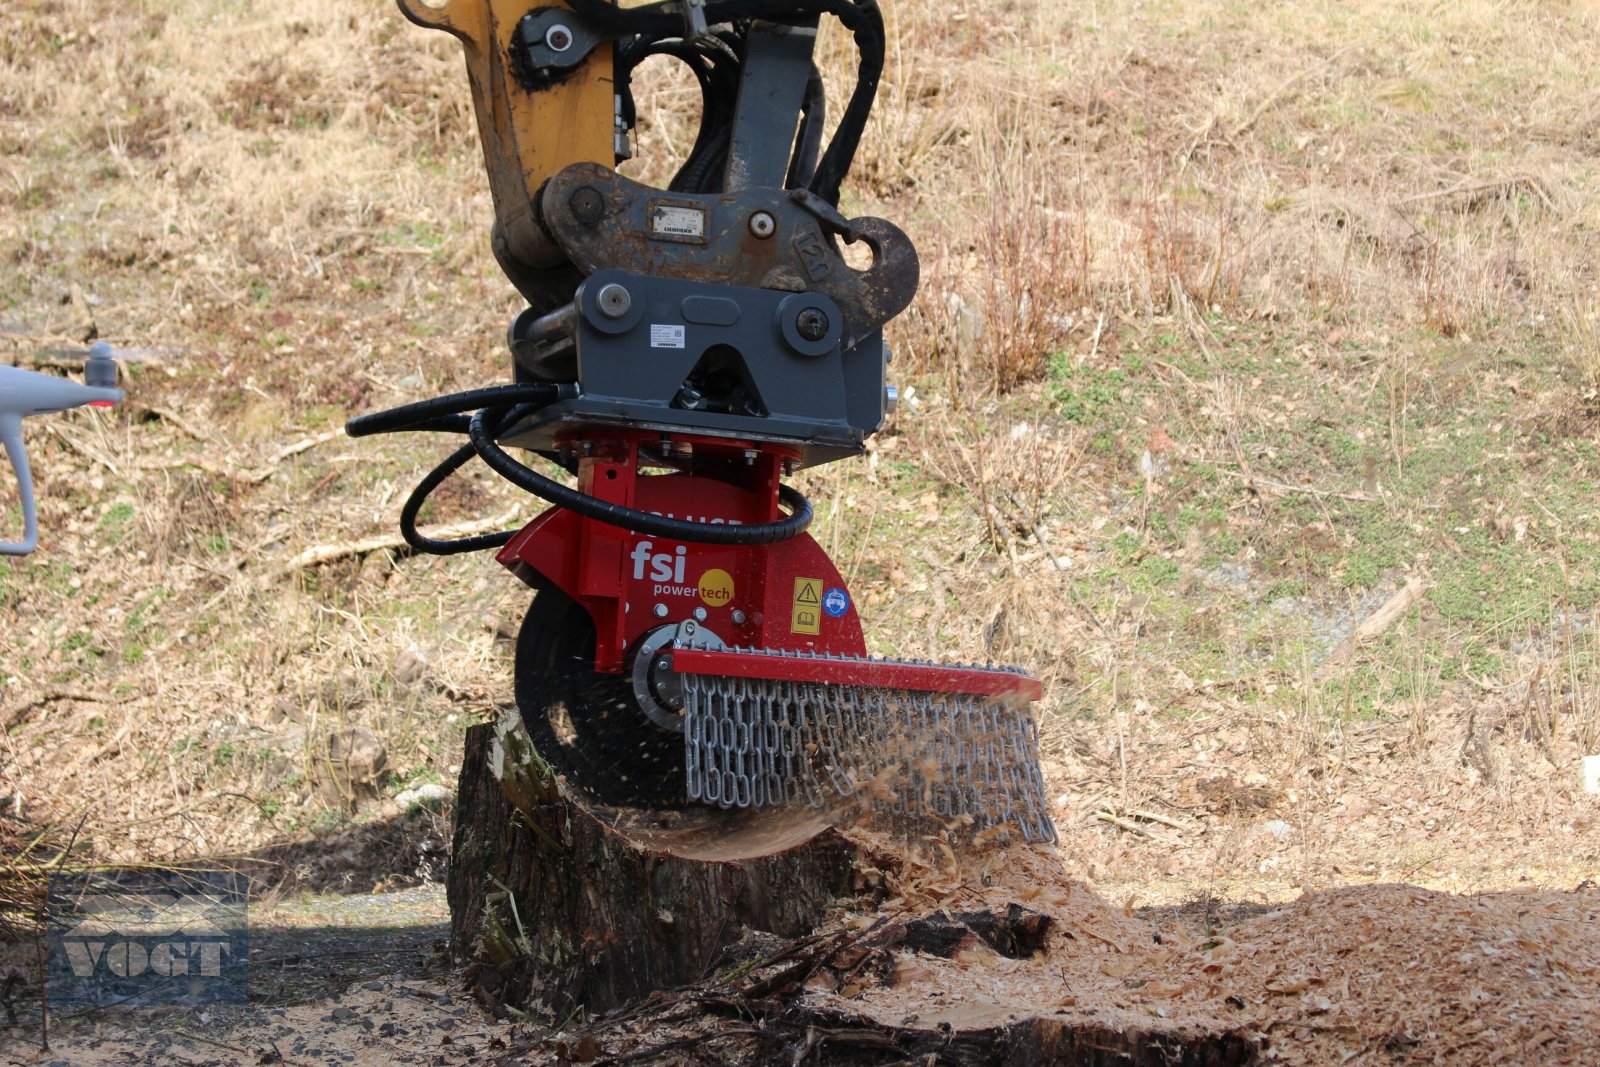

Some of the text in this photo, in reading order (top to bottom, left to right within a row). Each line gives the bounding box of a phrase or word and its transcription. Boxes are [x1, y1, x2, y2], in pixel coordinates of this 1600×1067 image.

[630, 540, 687, 584] fsi
[653, 584, 730, 600] power tech
